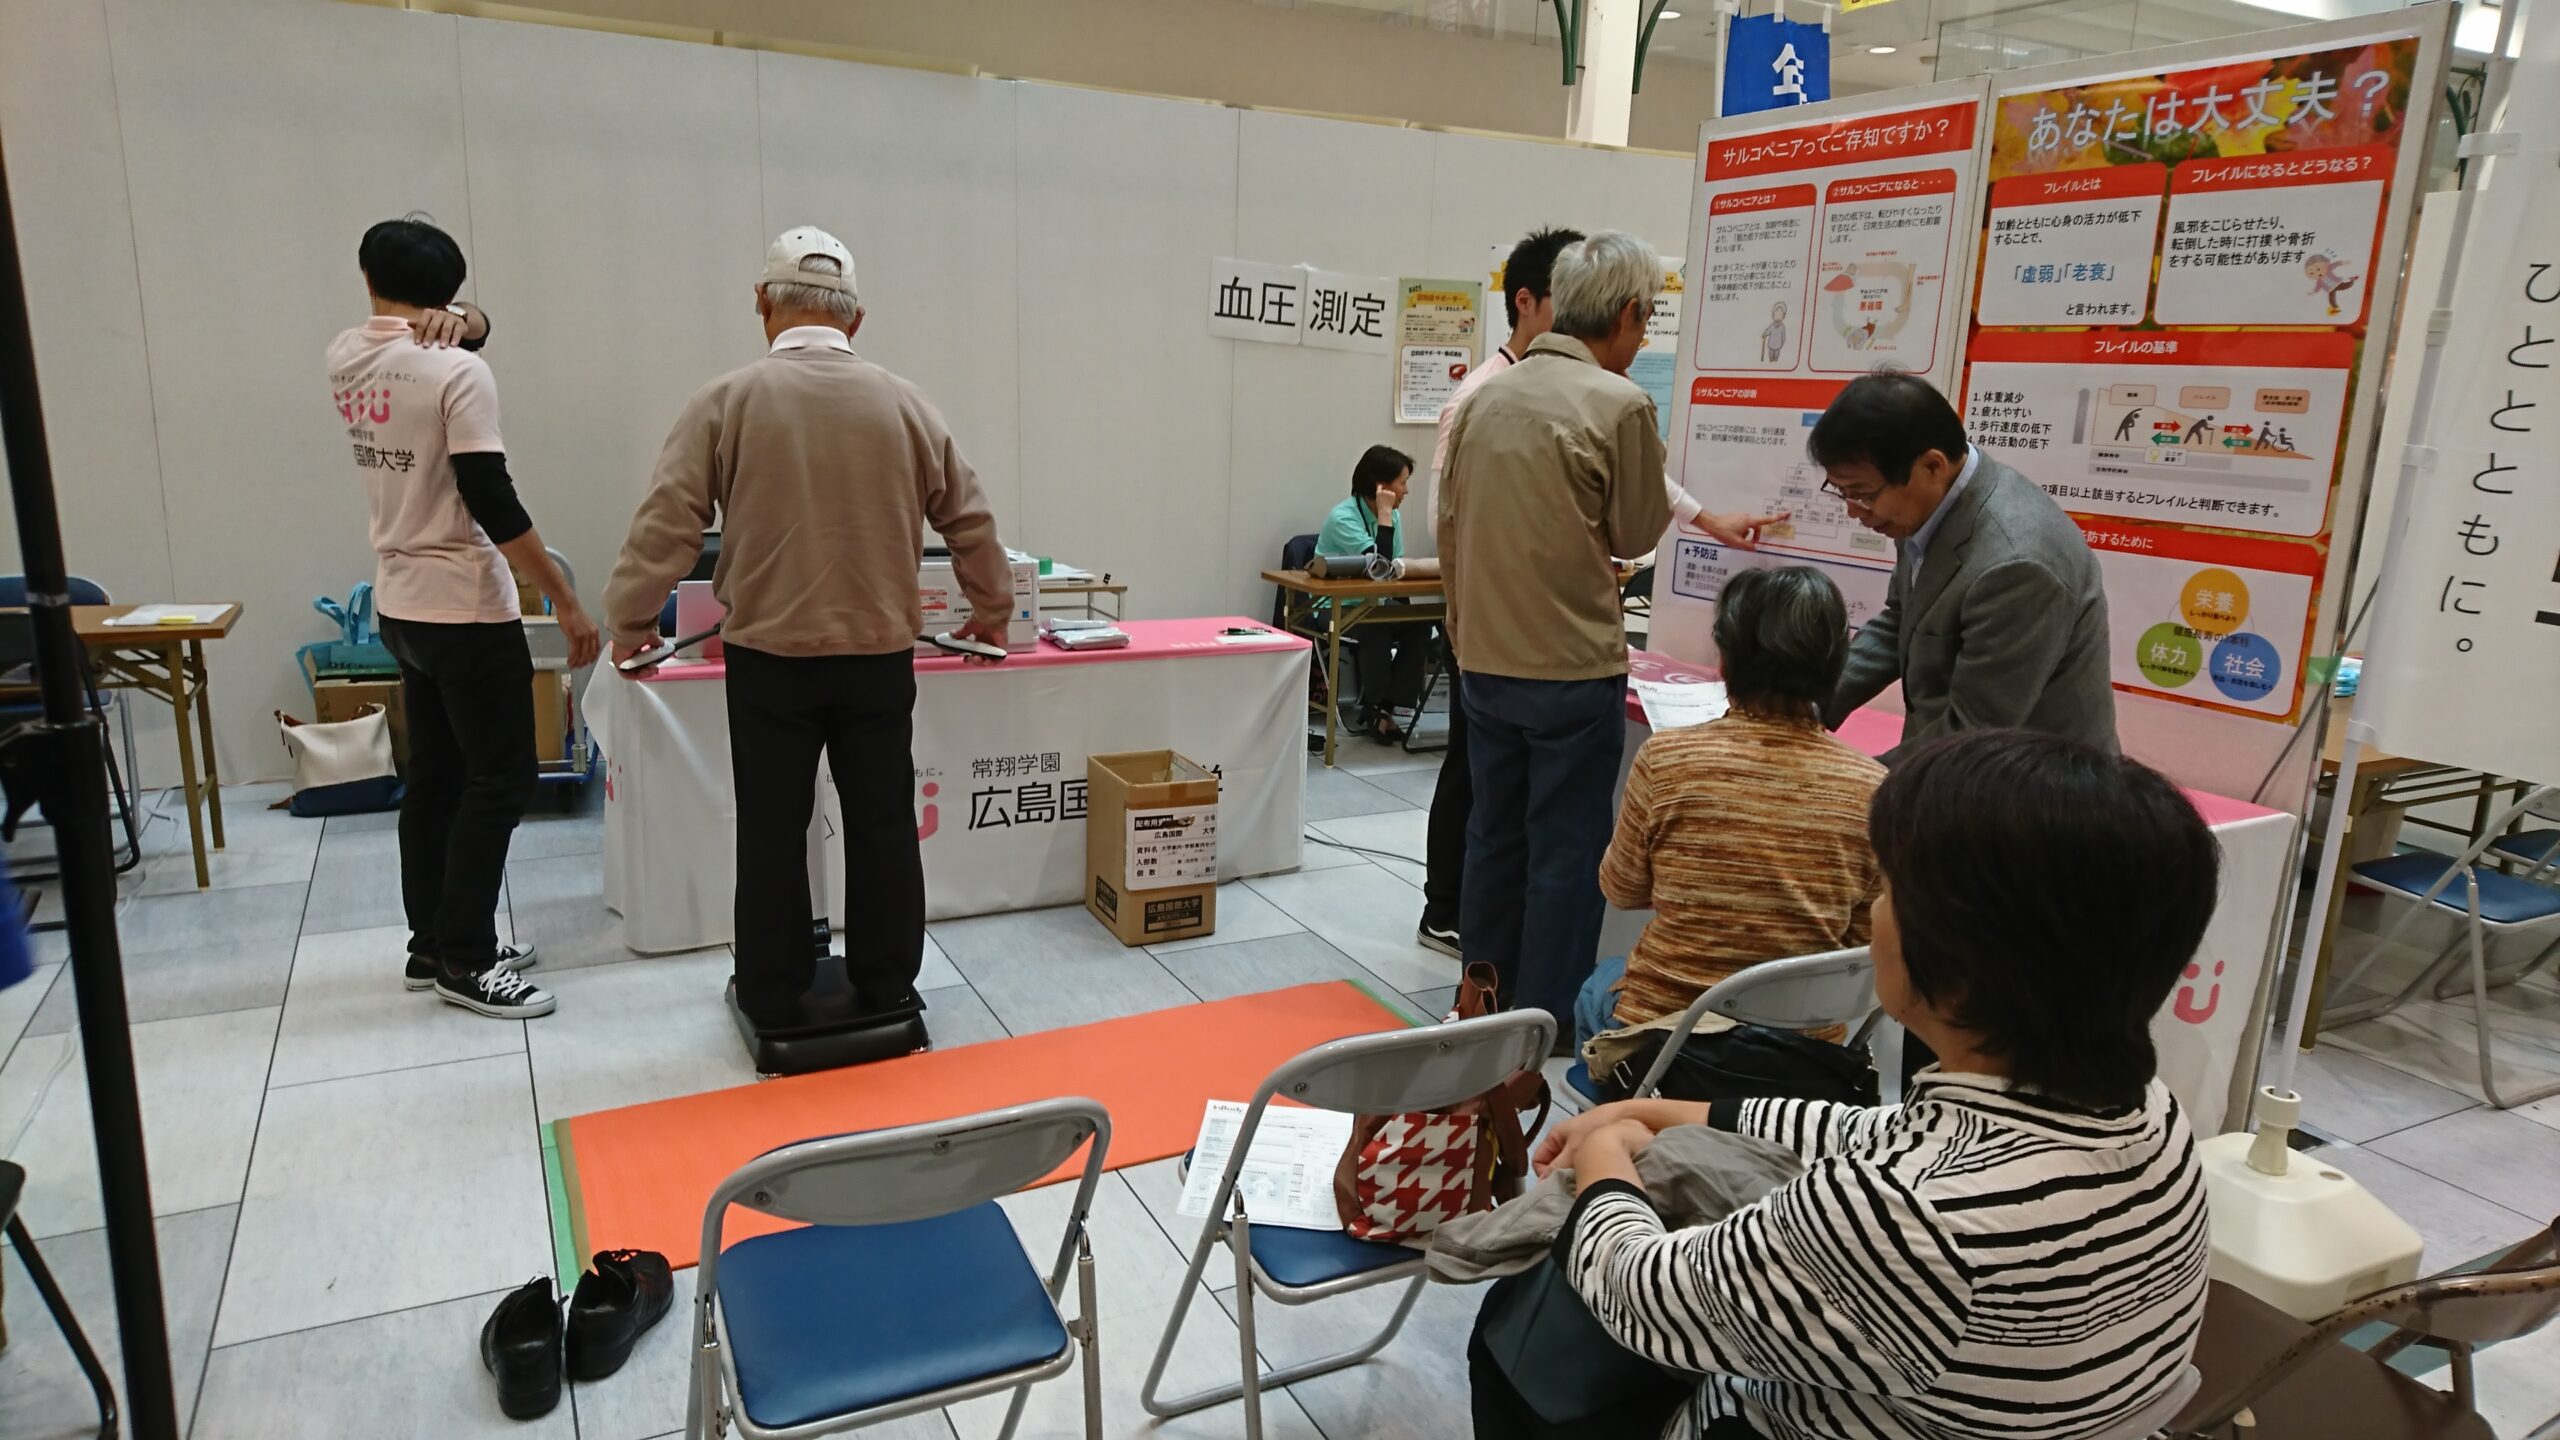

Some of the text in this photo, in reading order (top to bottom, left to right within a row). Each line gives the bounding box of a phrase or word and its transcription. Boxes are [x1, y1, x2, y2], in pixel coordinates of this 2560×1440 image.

[2028, 70, 2390, 151] あなたは大丈夫？
[1723, 119, 1949, 167] サルコペニアってご存知ですか？
[2191, 156, 2372, 183] フレイルになるとどうなる？
[2043, 178, 2103, 194] フレイルとは
[1995, 210, 2142, 232] 加齢とともに心身の活力が低下
[2173, 216, 2286, 235] 風邪をこじらせたり、
[1994, 231, 2043, 246] することで、
[2171, 231, 2316, 251] 転倒した時に打撲や骨折
[2169, 249, 2306, 268] をする可能性があります
[2014, 262, 2116, 284] 「虚弱」「老衰」
[1214, 276, 1387, 338] 血圧 測定
[2066, 303, 2136, 316] と言われます。
[2094, 340, 2179, 354] フレイルの基準
[1983, 391, 2025, 404] 体重減少
[1981, 405, 2033, 418] 疲れやすい
[1979, 420, 2053, 434] 歩行速度の低下
[1977, 434, 2051, 449] 身体活動の低下
[2440, 263, 2560, 652] ひととともに。
[1692, 545, 1719, 561] 予防法
[2195, 589, 2235, 613] 栄養
[2150, 641, 2188, 666] 体力
[2224, 652, 2266, 679] 社会
[972, 752, 1061, 779] 常翔学園
[1154, 826, 1216, 839] 広島国際 大学
